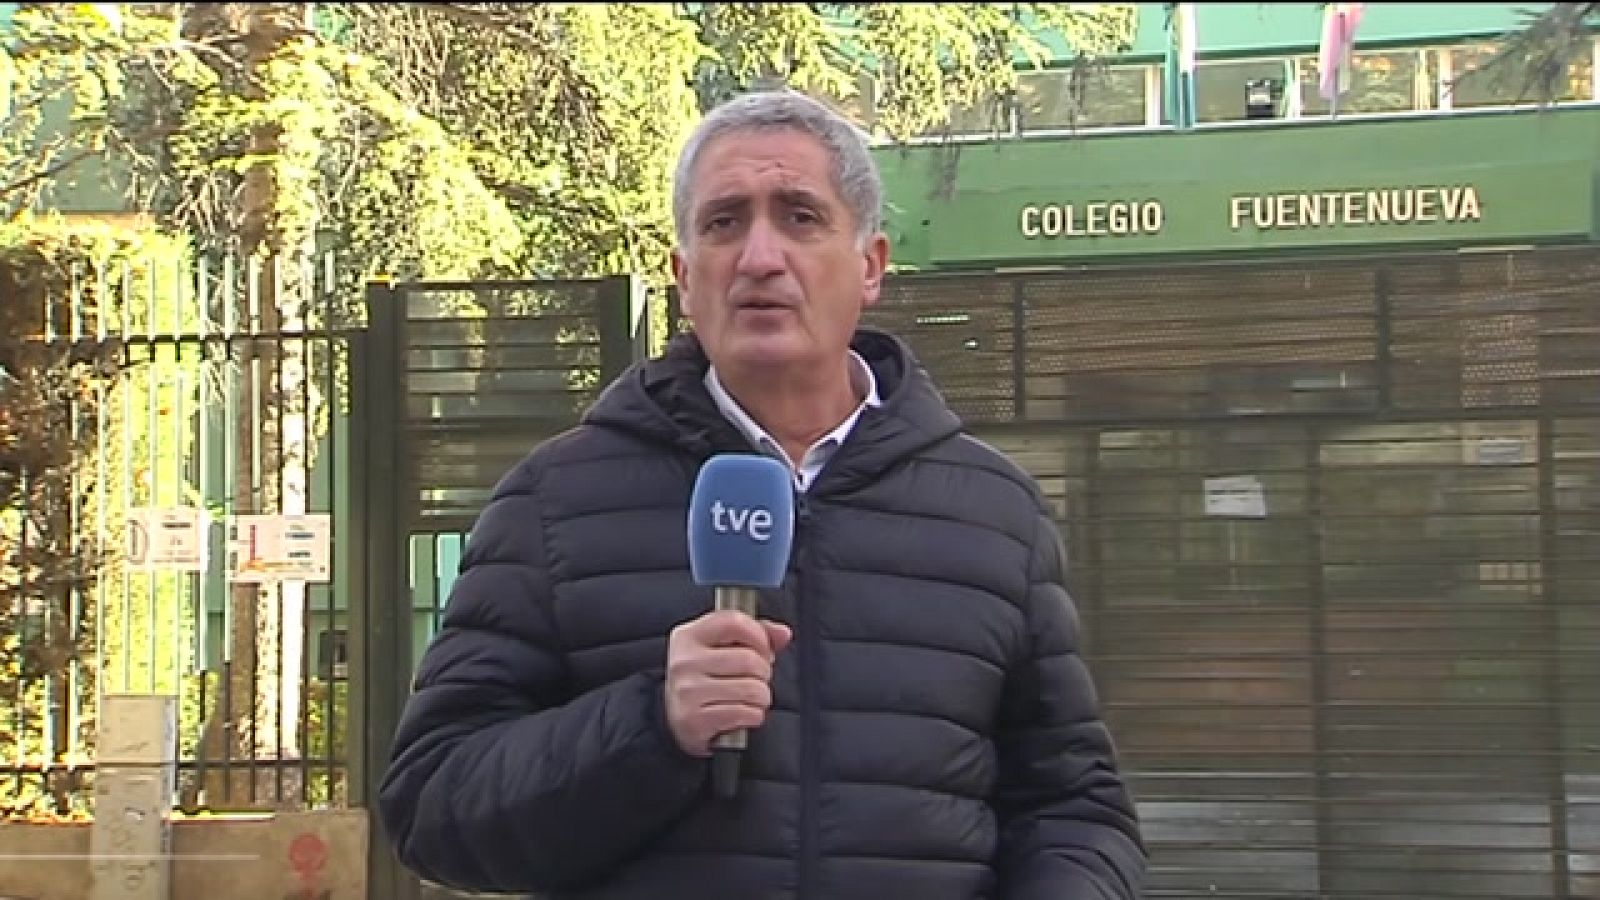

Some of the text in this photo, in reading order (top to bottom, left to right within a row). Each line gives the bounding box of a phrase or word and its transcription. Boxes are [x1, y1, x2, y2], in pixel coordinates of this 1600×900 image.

[1021, 187, 1481, 237] COLEGIO FUENTENUEVA
[710, 500, 773, 541] tve
